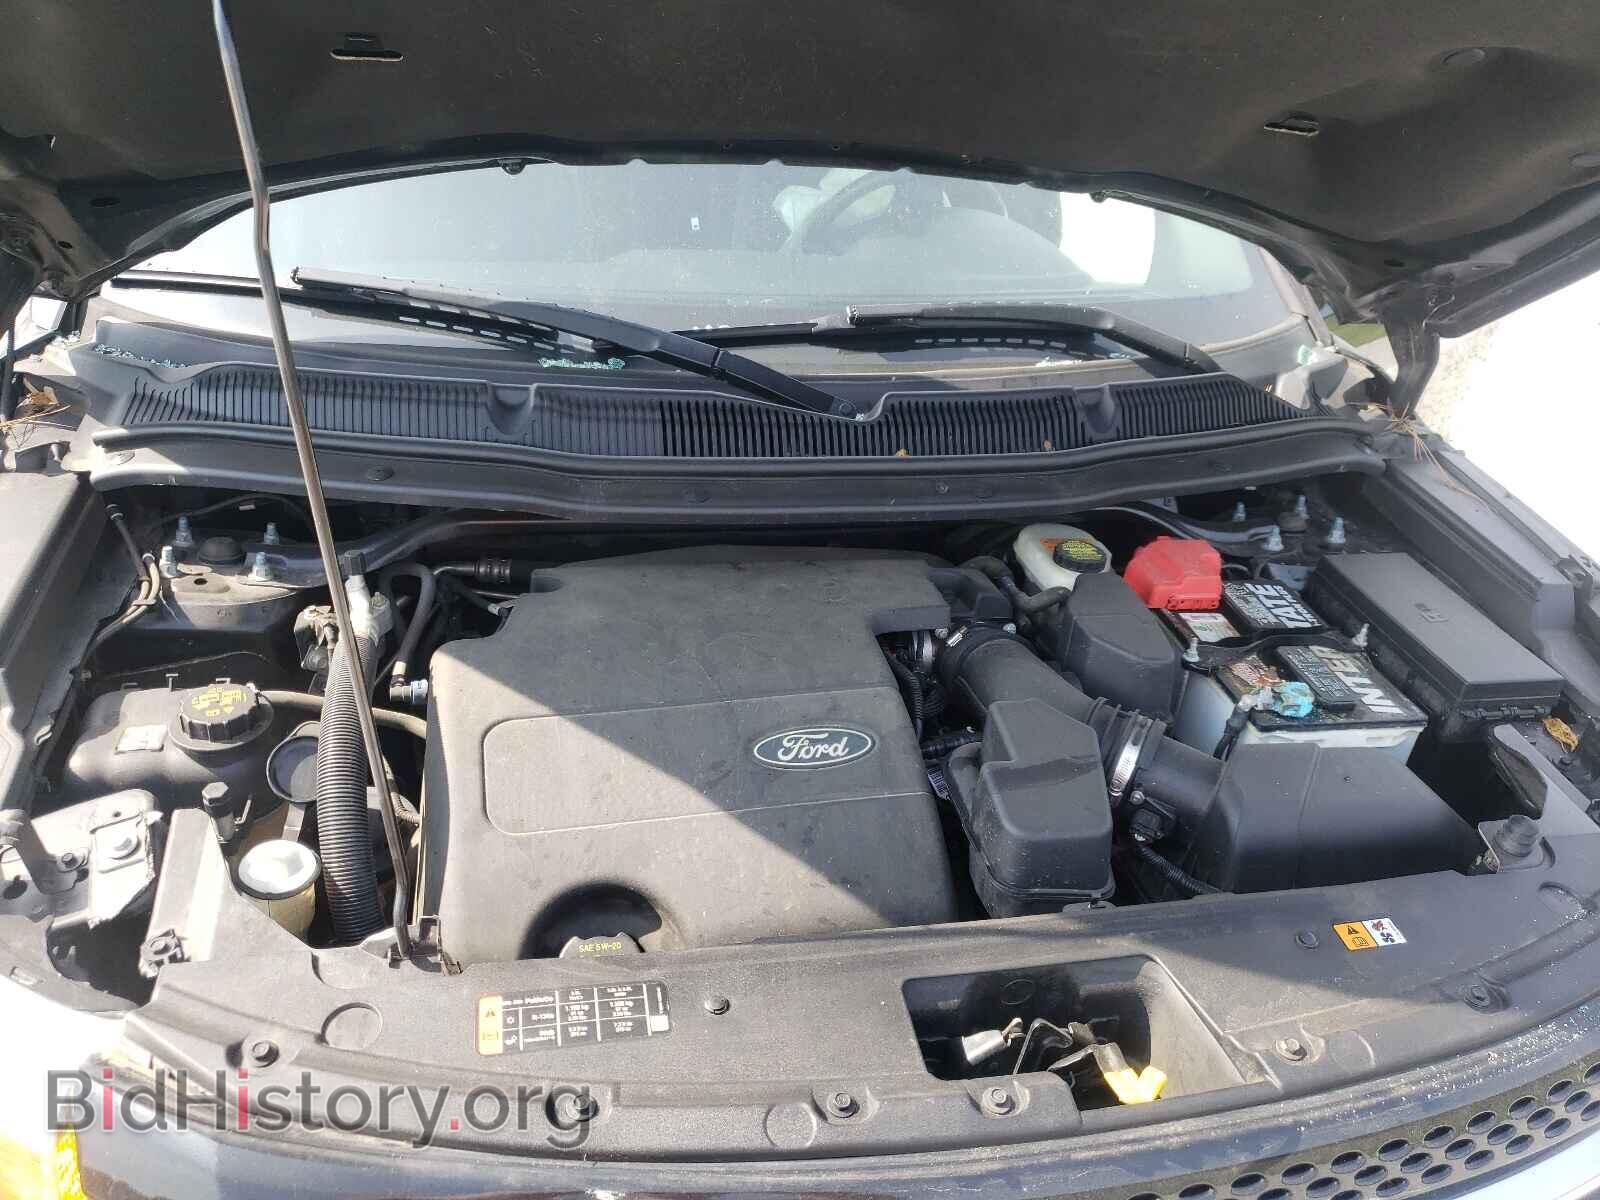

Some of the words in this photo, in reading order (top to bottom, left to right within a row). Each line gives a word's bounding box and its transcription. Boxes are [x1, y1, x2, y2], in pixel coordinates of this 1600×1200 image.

[777, 732, 849, 761] Ford
[578, 943, 594, 953] SAE
[595, 941, 622, 951] 5W-20
